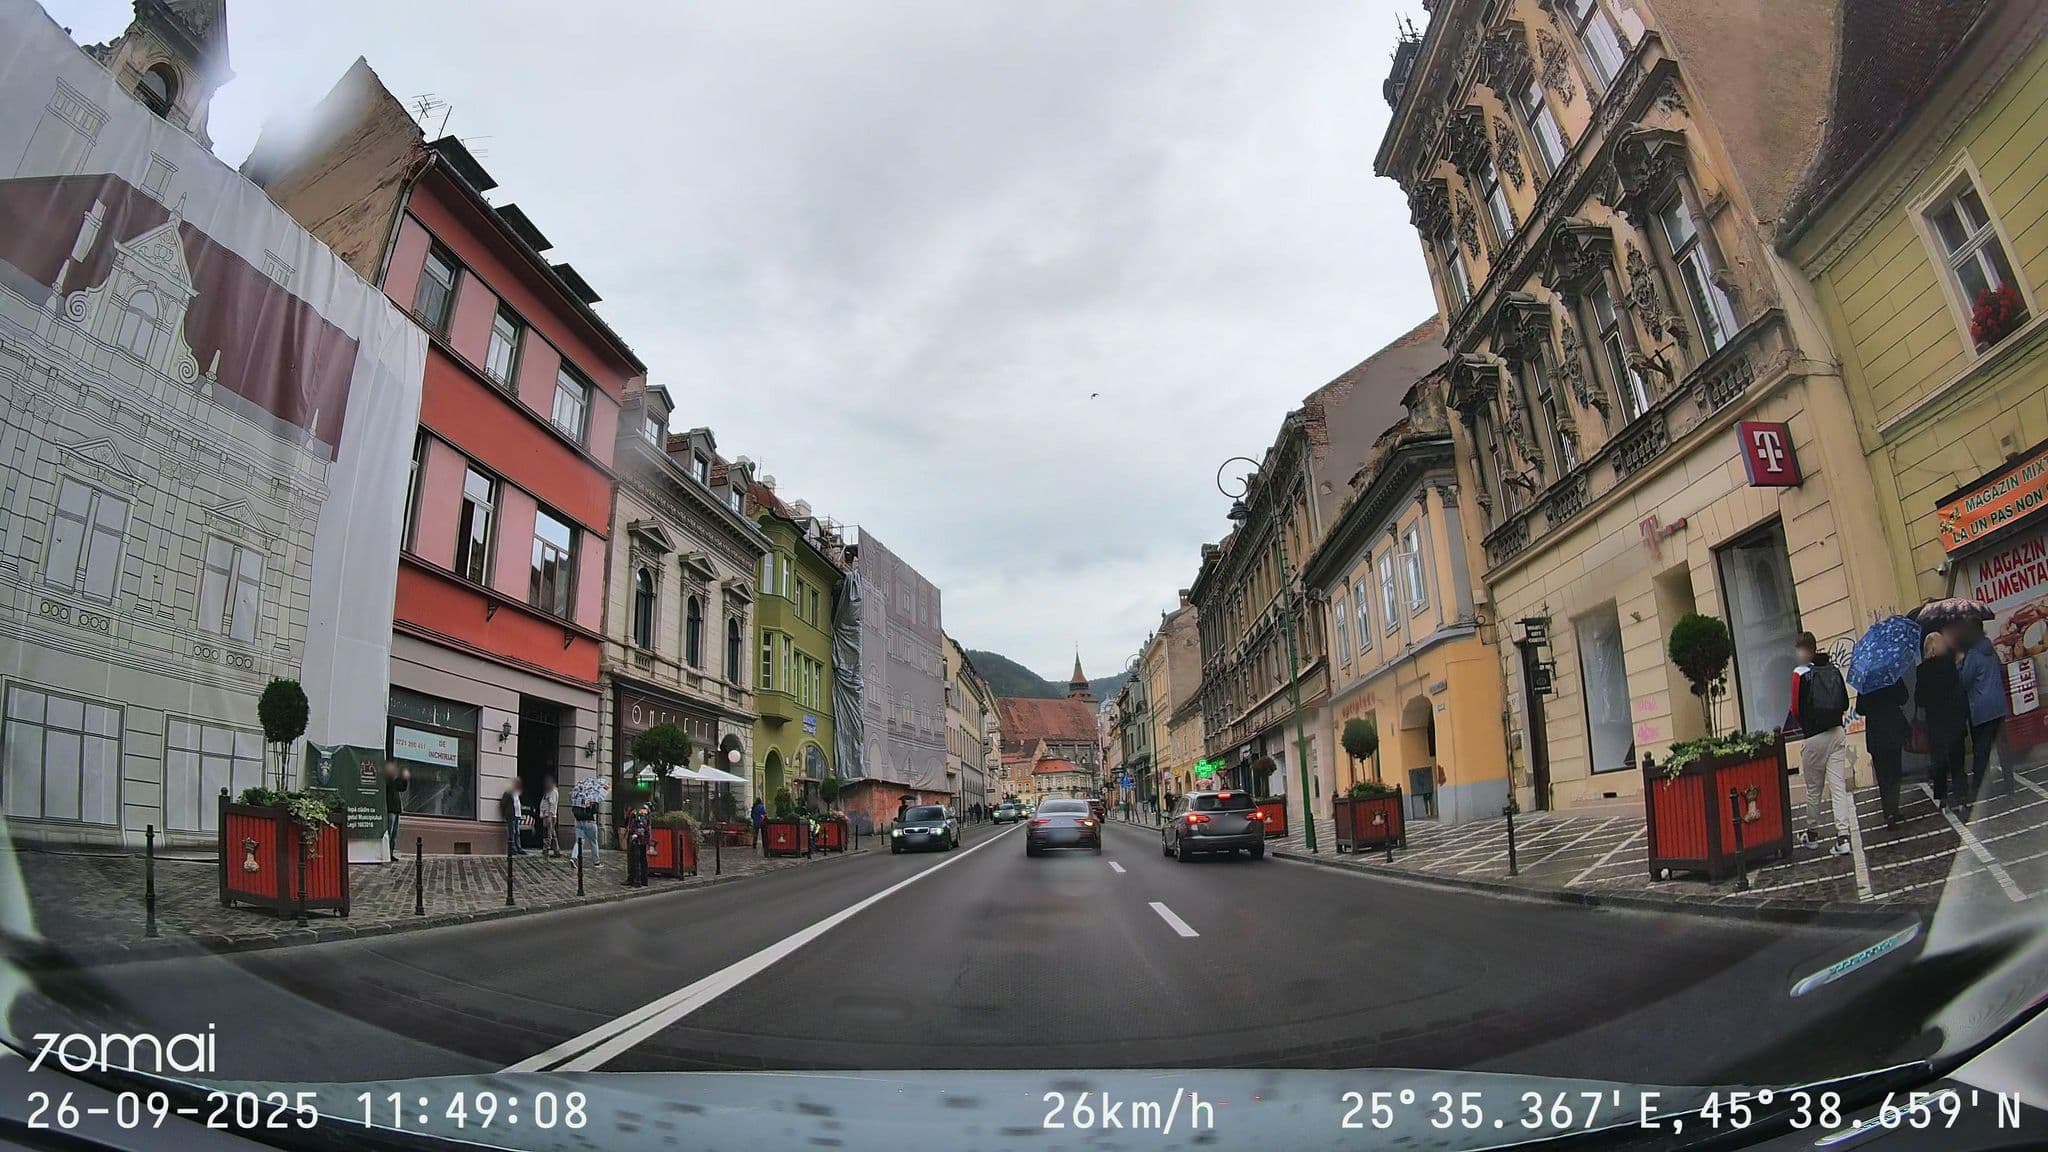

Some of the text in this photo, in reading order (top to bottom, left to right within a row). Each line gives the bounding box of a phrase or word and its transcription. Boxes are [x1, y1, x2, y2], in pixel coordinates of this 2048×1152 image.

[1753, 430, 1784, 472] T
[1965, 473, 2020, 513] MAGAZIN
[2022, 455, 2048, 484] MIX
[1952, 530, 1969, 544] LA
[1970, 519, 1988, 535] UN
[1991, 504, 2014, 526] PAS
[2015, 488, 2043, 513] NON
[1975, 558, 2048, 605] ALIMENTA
[1979, 535, 2047, 583] MAGAZIN
